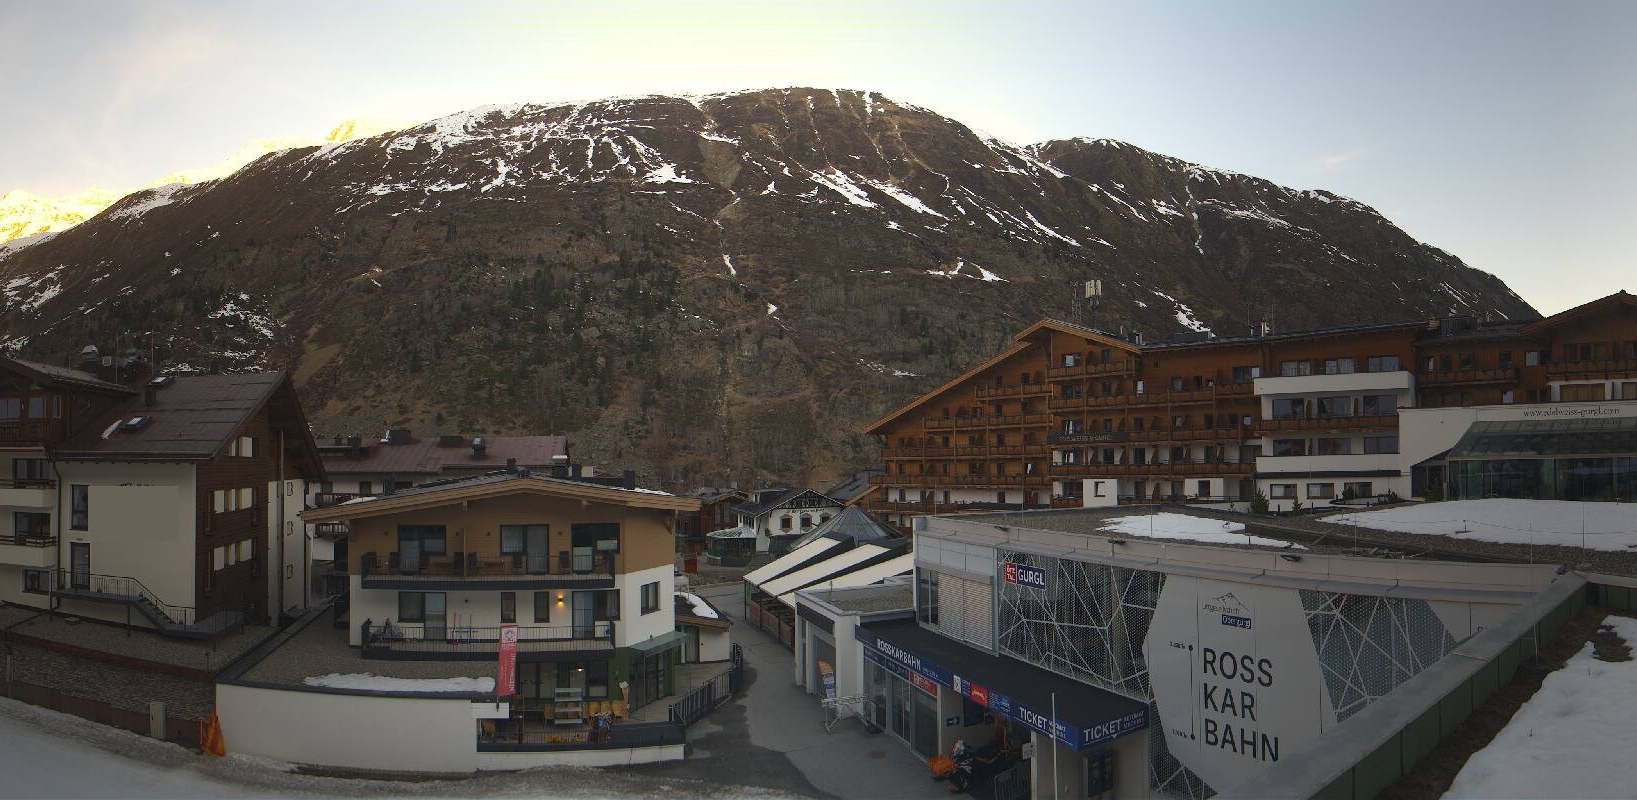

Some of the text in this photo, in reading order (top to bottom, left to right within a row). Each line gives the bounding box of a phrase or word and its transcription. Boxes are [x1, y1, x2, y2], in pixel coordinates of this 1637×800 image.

[1018, 569, 1044, 585] GURGL
[877, 638, 921, 671] ROSSKARBAHN
[1203, 647, 1273, 687] ROSS
[1203, 682, 1256, 721] KAR
[1019, 707, 1047, 730] TICKET
[1084, 718, 1123, 742] TICKET
[1205, 718, 1279, 762] BAHN
